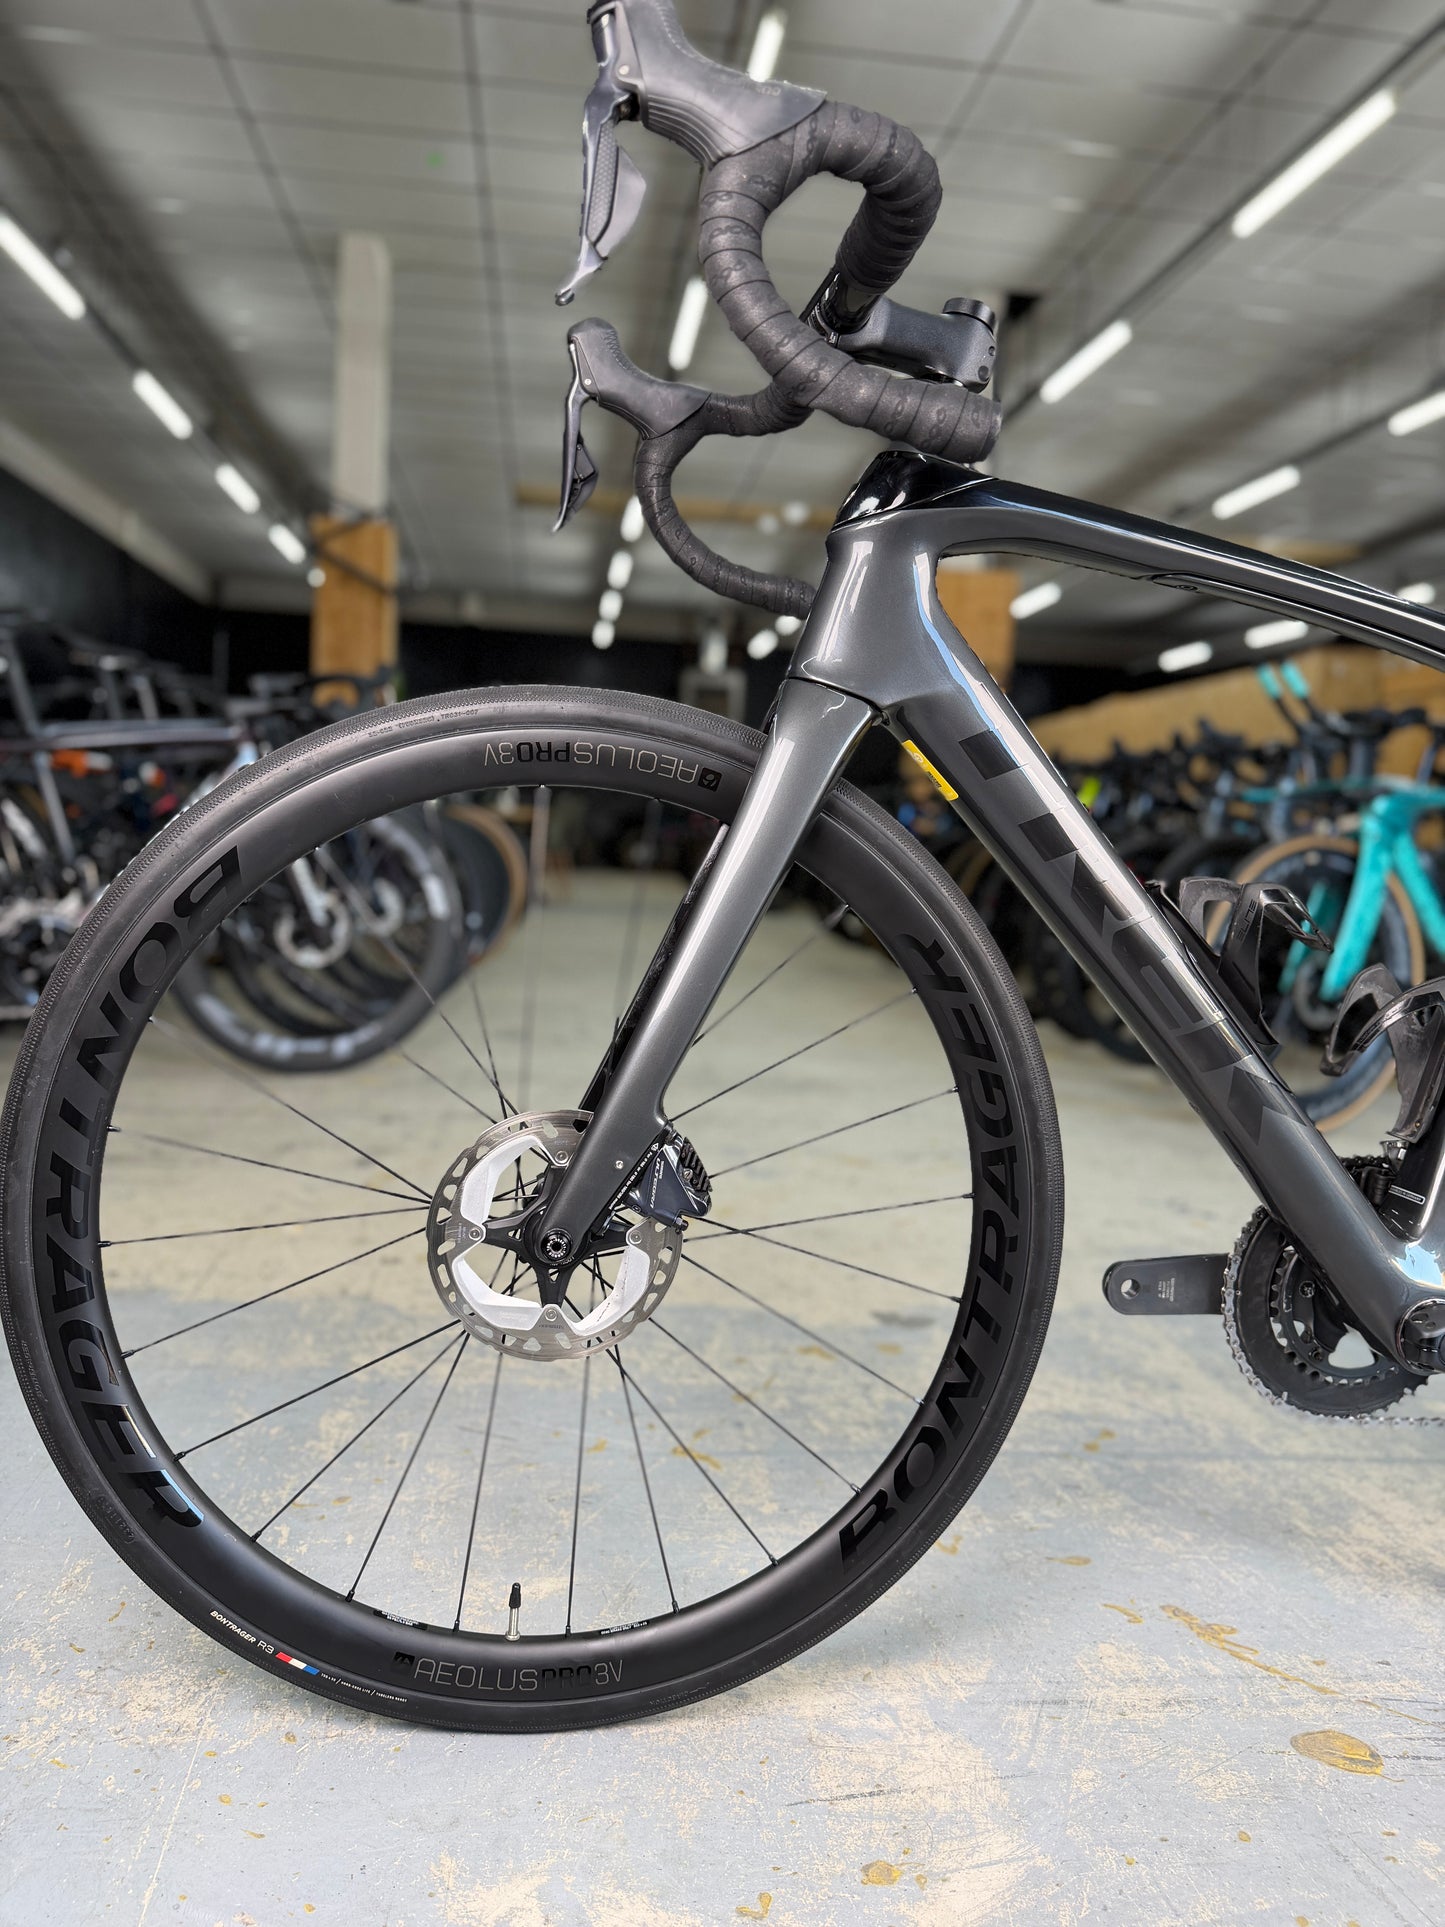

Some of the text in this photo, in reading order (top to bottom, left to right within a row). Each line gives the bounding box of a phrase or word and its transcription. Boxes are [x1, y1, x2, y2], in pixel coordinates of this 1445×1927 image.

[838, 932, 1020, 1574] BONTRAGER
[209, 1609, 275, 1655] BONTRAGER R3
